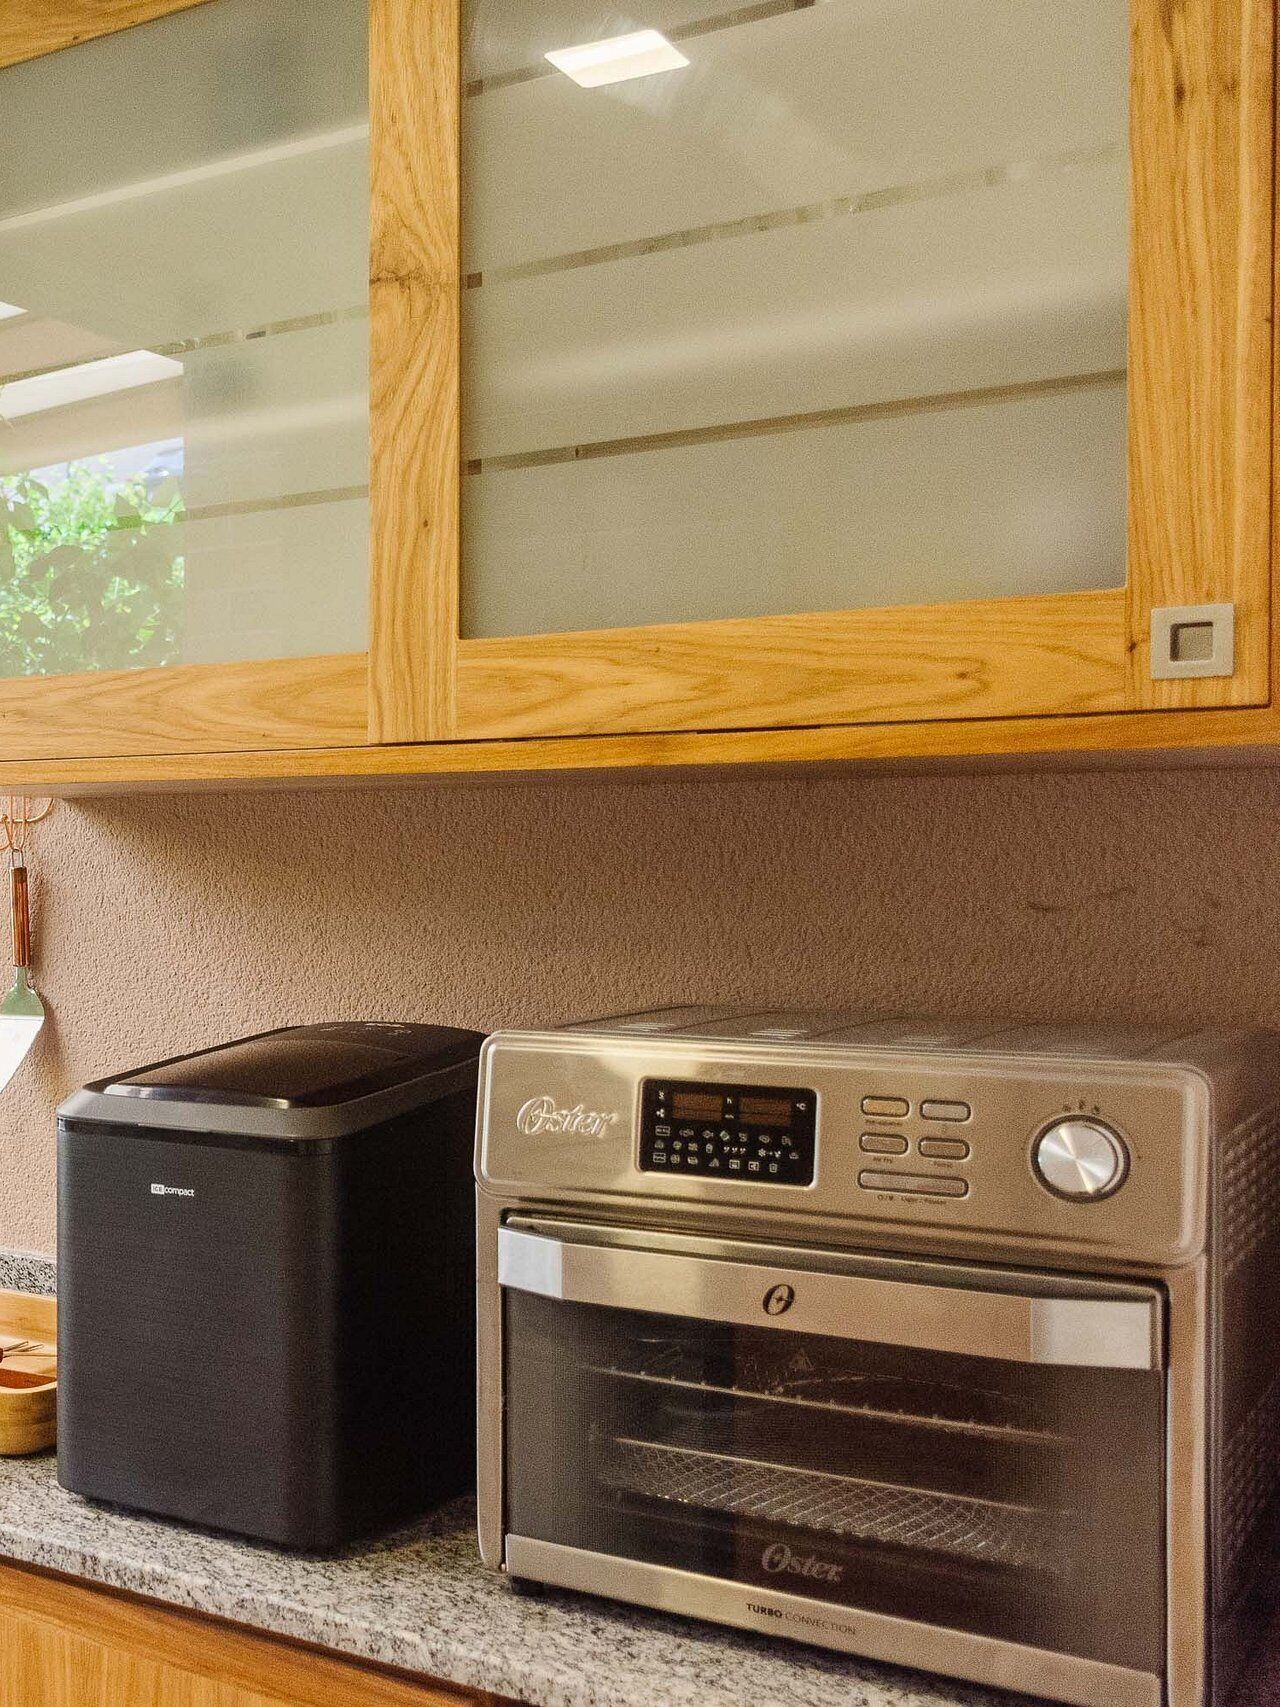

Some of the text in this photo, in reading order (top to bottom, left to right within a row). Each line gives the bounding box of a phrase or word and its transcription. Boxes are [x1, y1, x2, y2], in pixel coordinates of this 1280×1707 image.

[516, 1095, 619, 1139] Oster
[762, 1543, 845, 1584] Oster
[746, 1602, 857, 1636] TURBO CONVECTION
